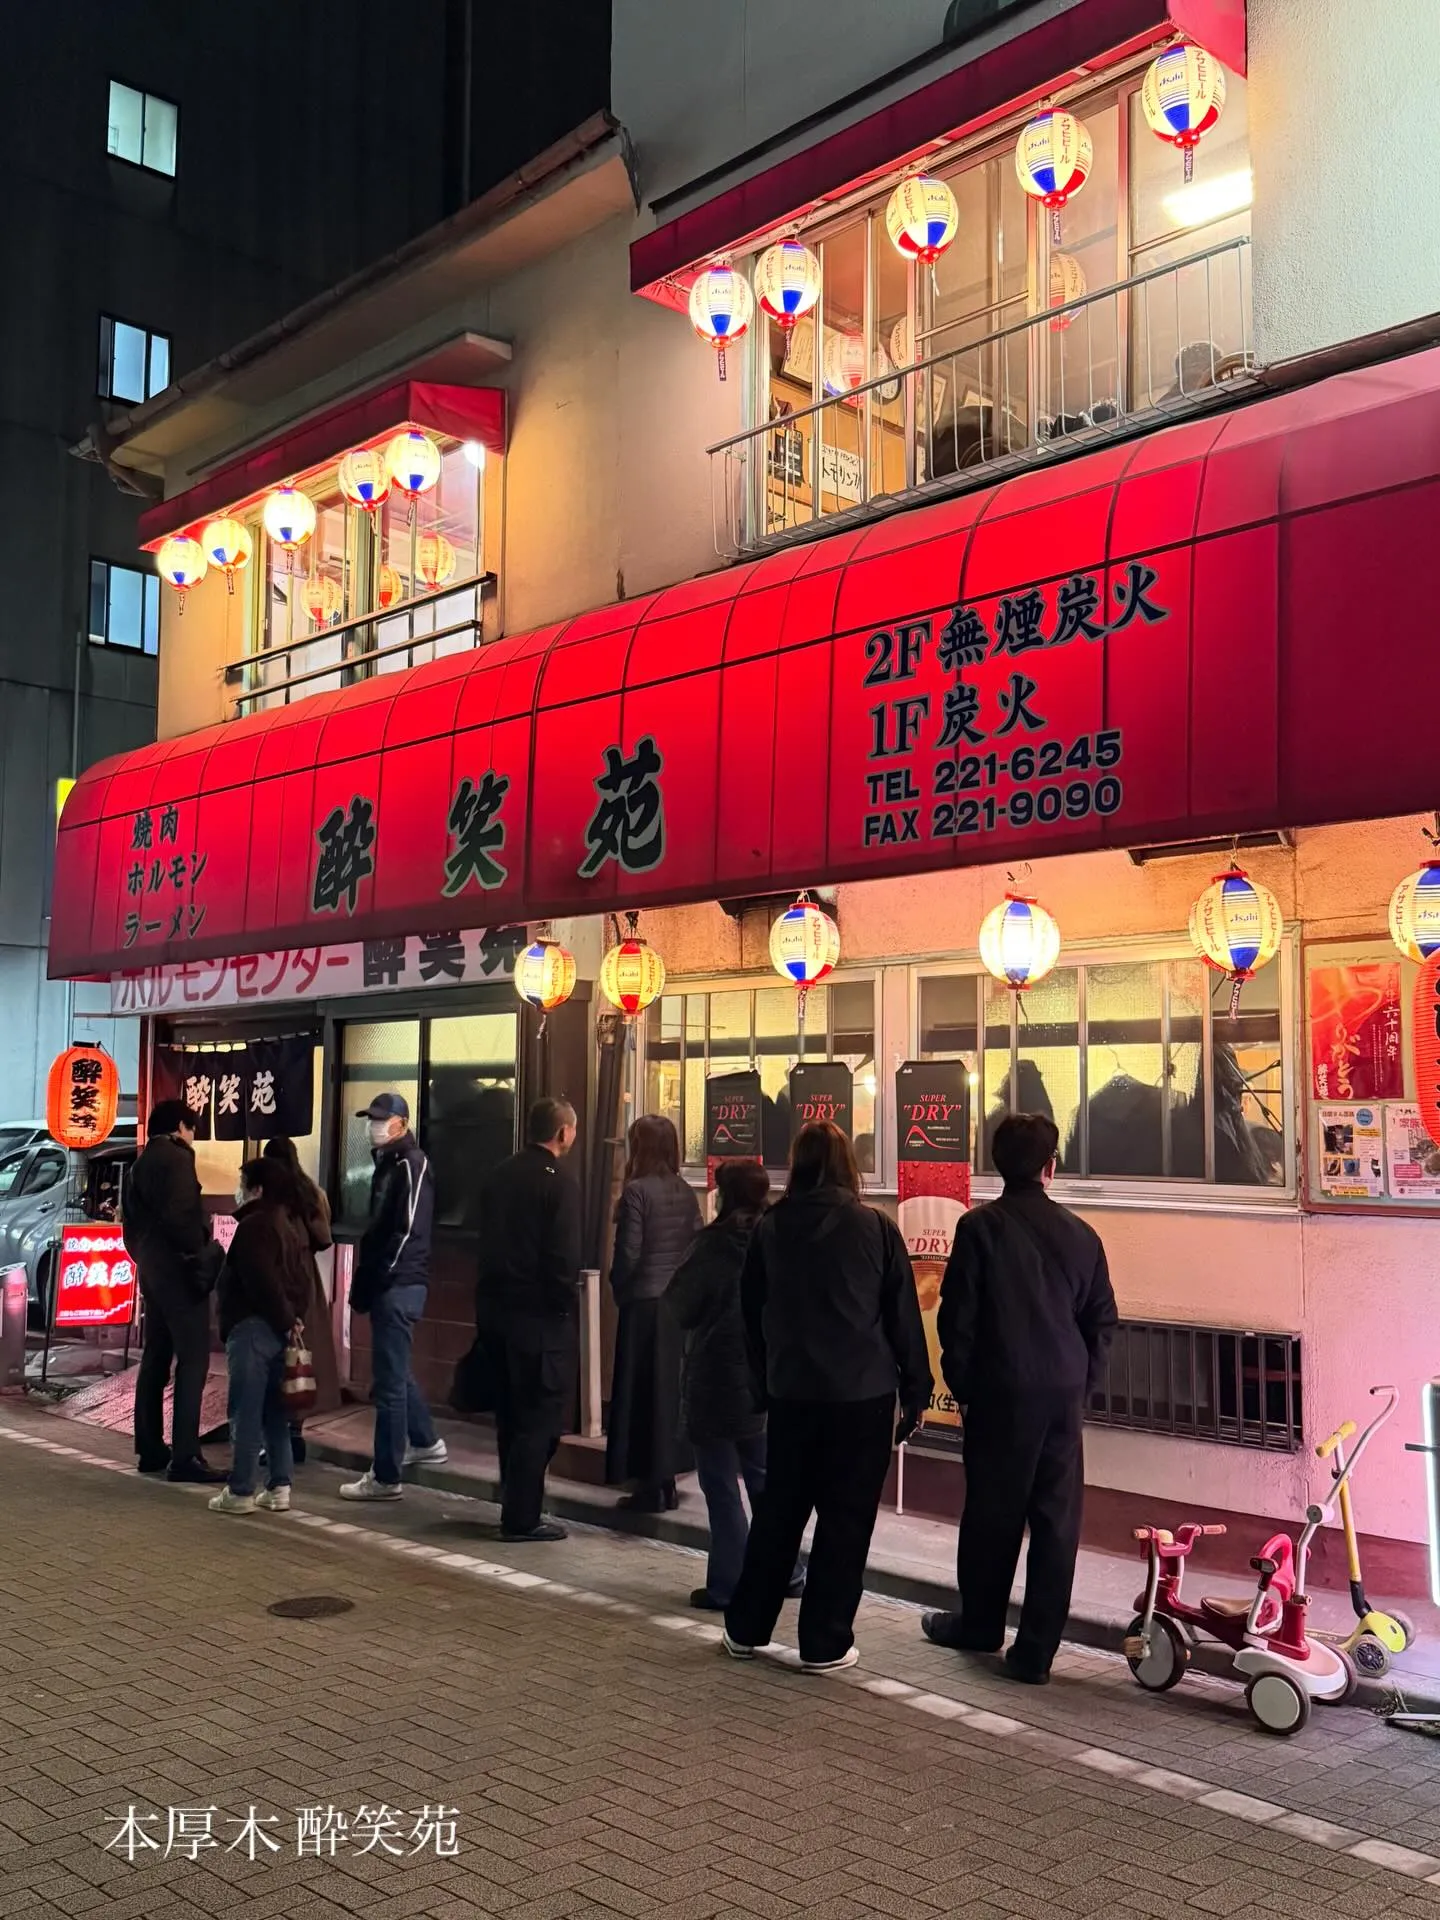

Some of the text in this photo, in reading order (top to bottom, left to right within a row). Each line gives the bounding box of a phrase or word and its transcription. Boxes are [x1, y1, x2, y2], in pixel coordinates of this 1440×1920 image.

[1159, 71, 1184, 86] Asahi
[863, 561, 1170, 688] 2F無煙炭火
[867, 672, 1048, 760] 1F炭火
[866, 729, 1123, 804] TEL 221-6245
[130, 804, 178, 850] 焼肉
[863, 776, 1123, 847] FAX 221-9090
[127, 853, 208, 896] ホルモン
[123, 904, 206, 948] ラーメン
[1230, 911, 1259, 923] Asahi
[904, 1104, 961, 1121] "DRY"
[920, 1094, 946, 1102] SUPER
[908, 1238, 953, 1253] "DRY
